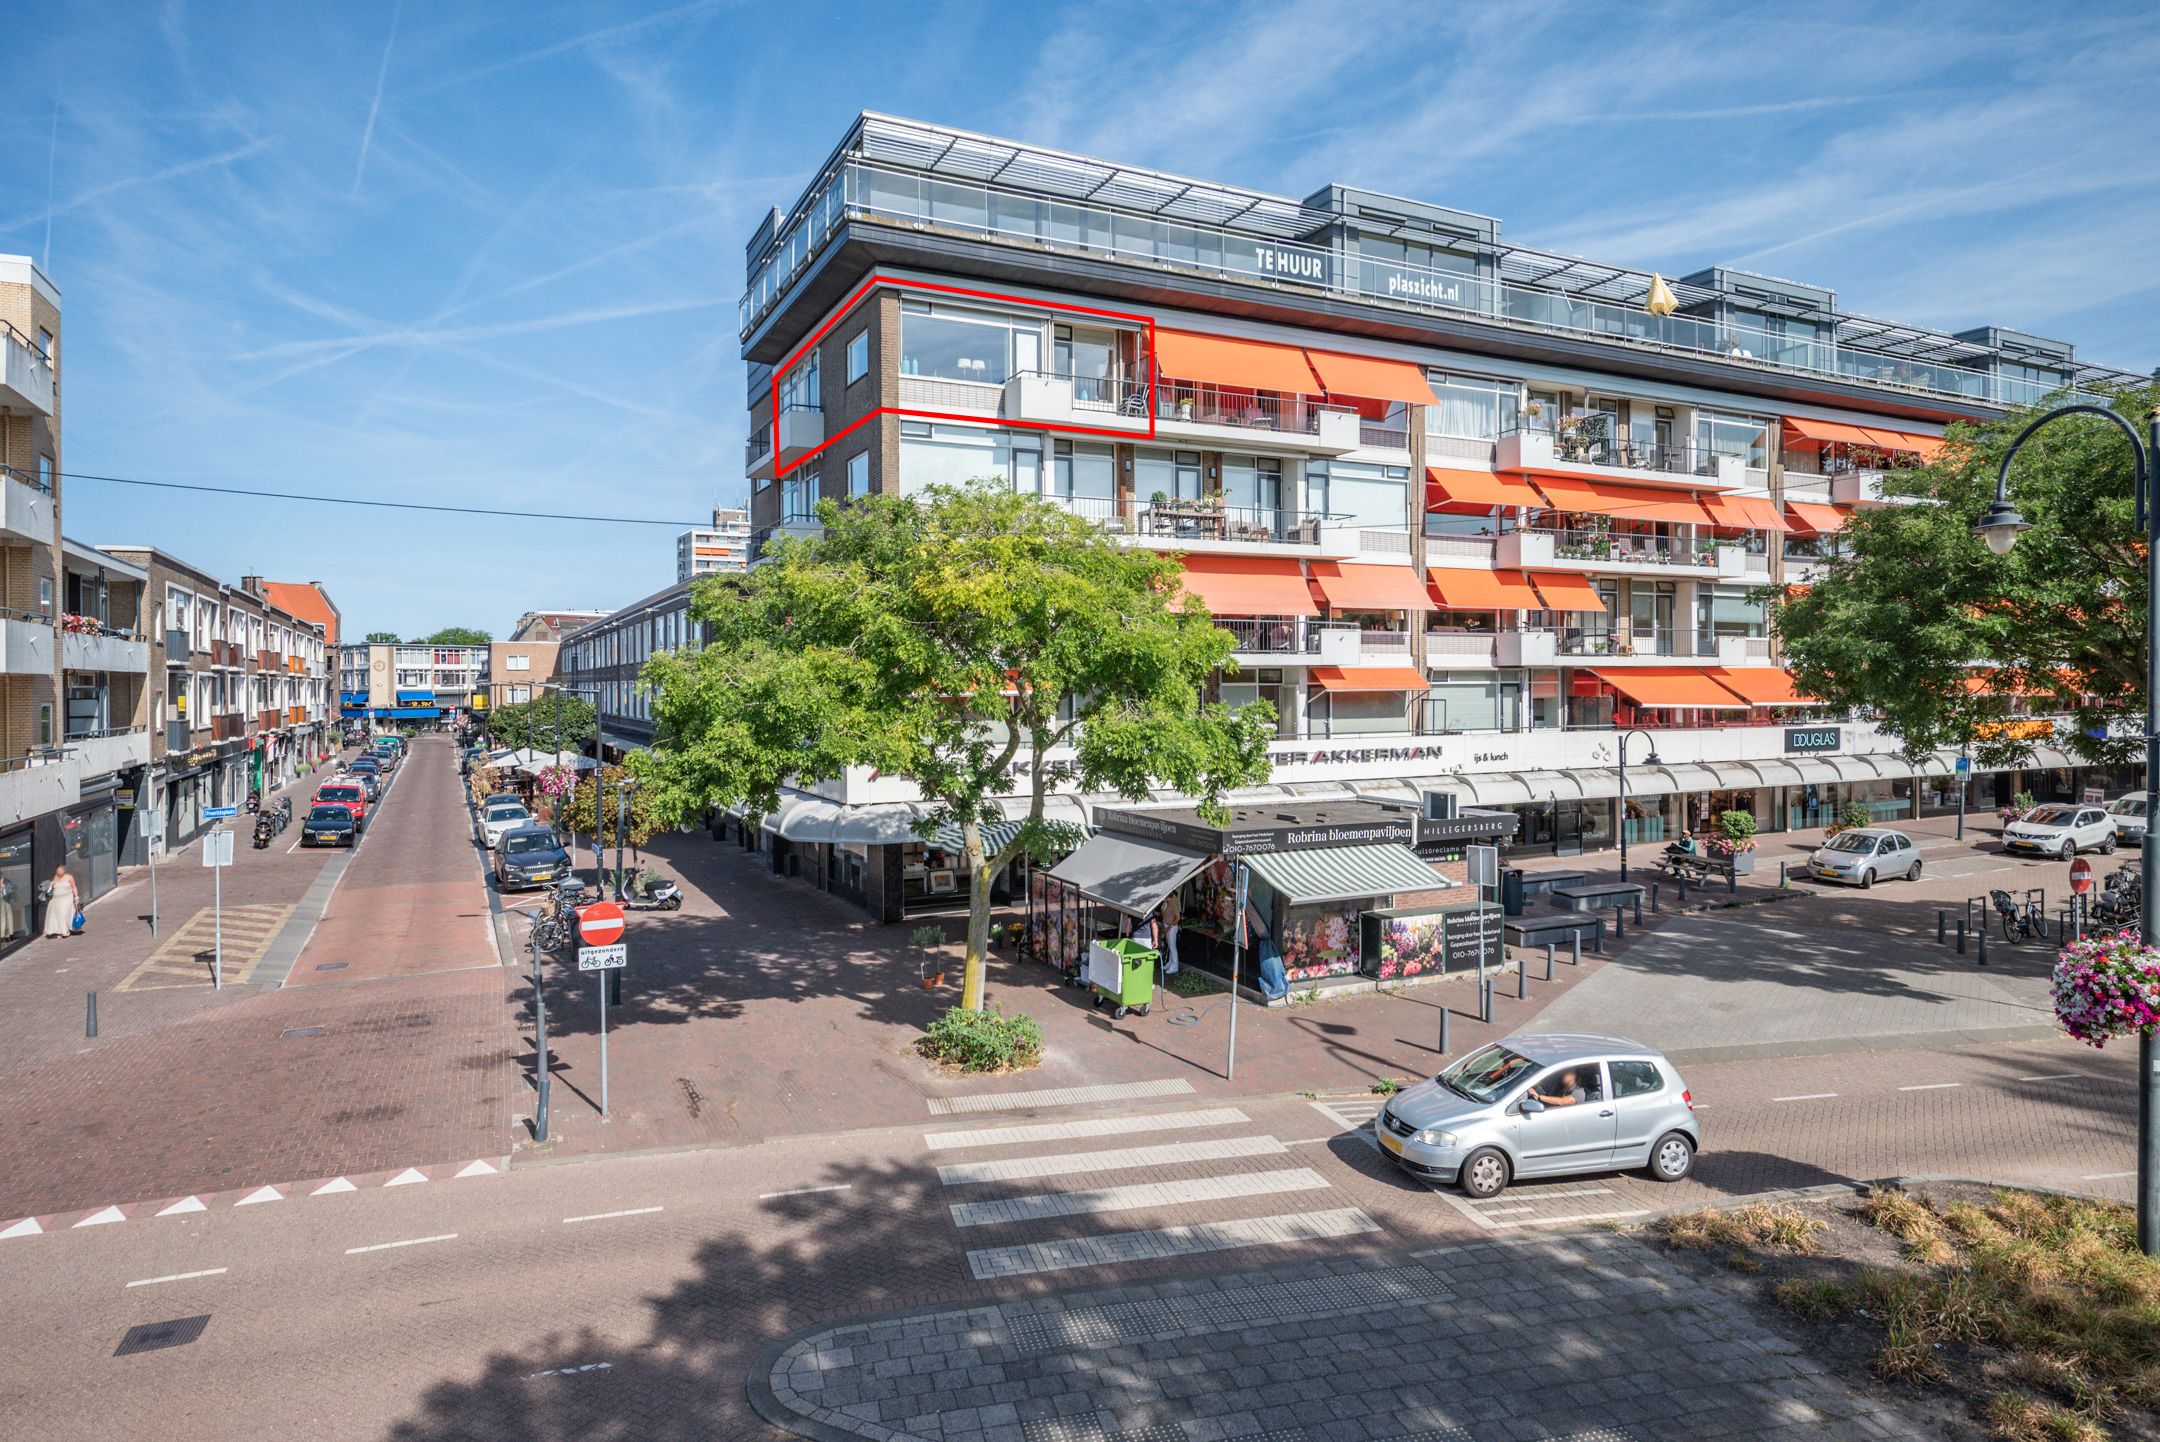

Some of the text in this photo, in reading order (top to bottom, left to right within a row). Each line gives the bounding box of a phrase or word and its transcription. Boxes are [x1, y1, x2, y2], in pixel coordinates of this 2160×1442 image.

[1255, 248, 1323, 279] TE HUUR
[1388, 273, 1459, 302] plaszicht.nl
[1793, 732, 1836, 747] DOUGLAS
[1263, 746, 1443, 767] TER AKKERMAN
[1474, 751, 1509, 764] ijs & lunch
[1287, 825, 1412, 844] Robrina bloemenpaviljoen
[1423, 822, 1503, 835] HILLEGERSBERG
[1229, 843, 1276, 853] 010-7670076
[1413, 846, 1466, 855] nul10reclame.n
[580, 946, 624, 955] uitgezonderd
